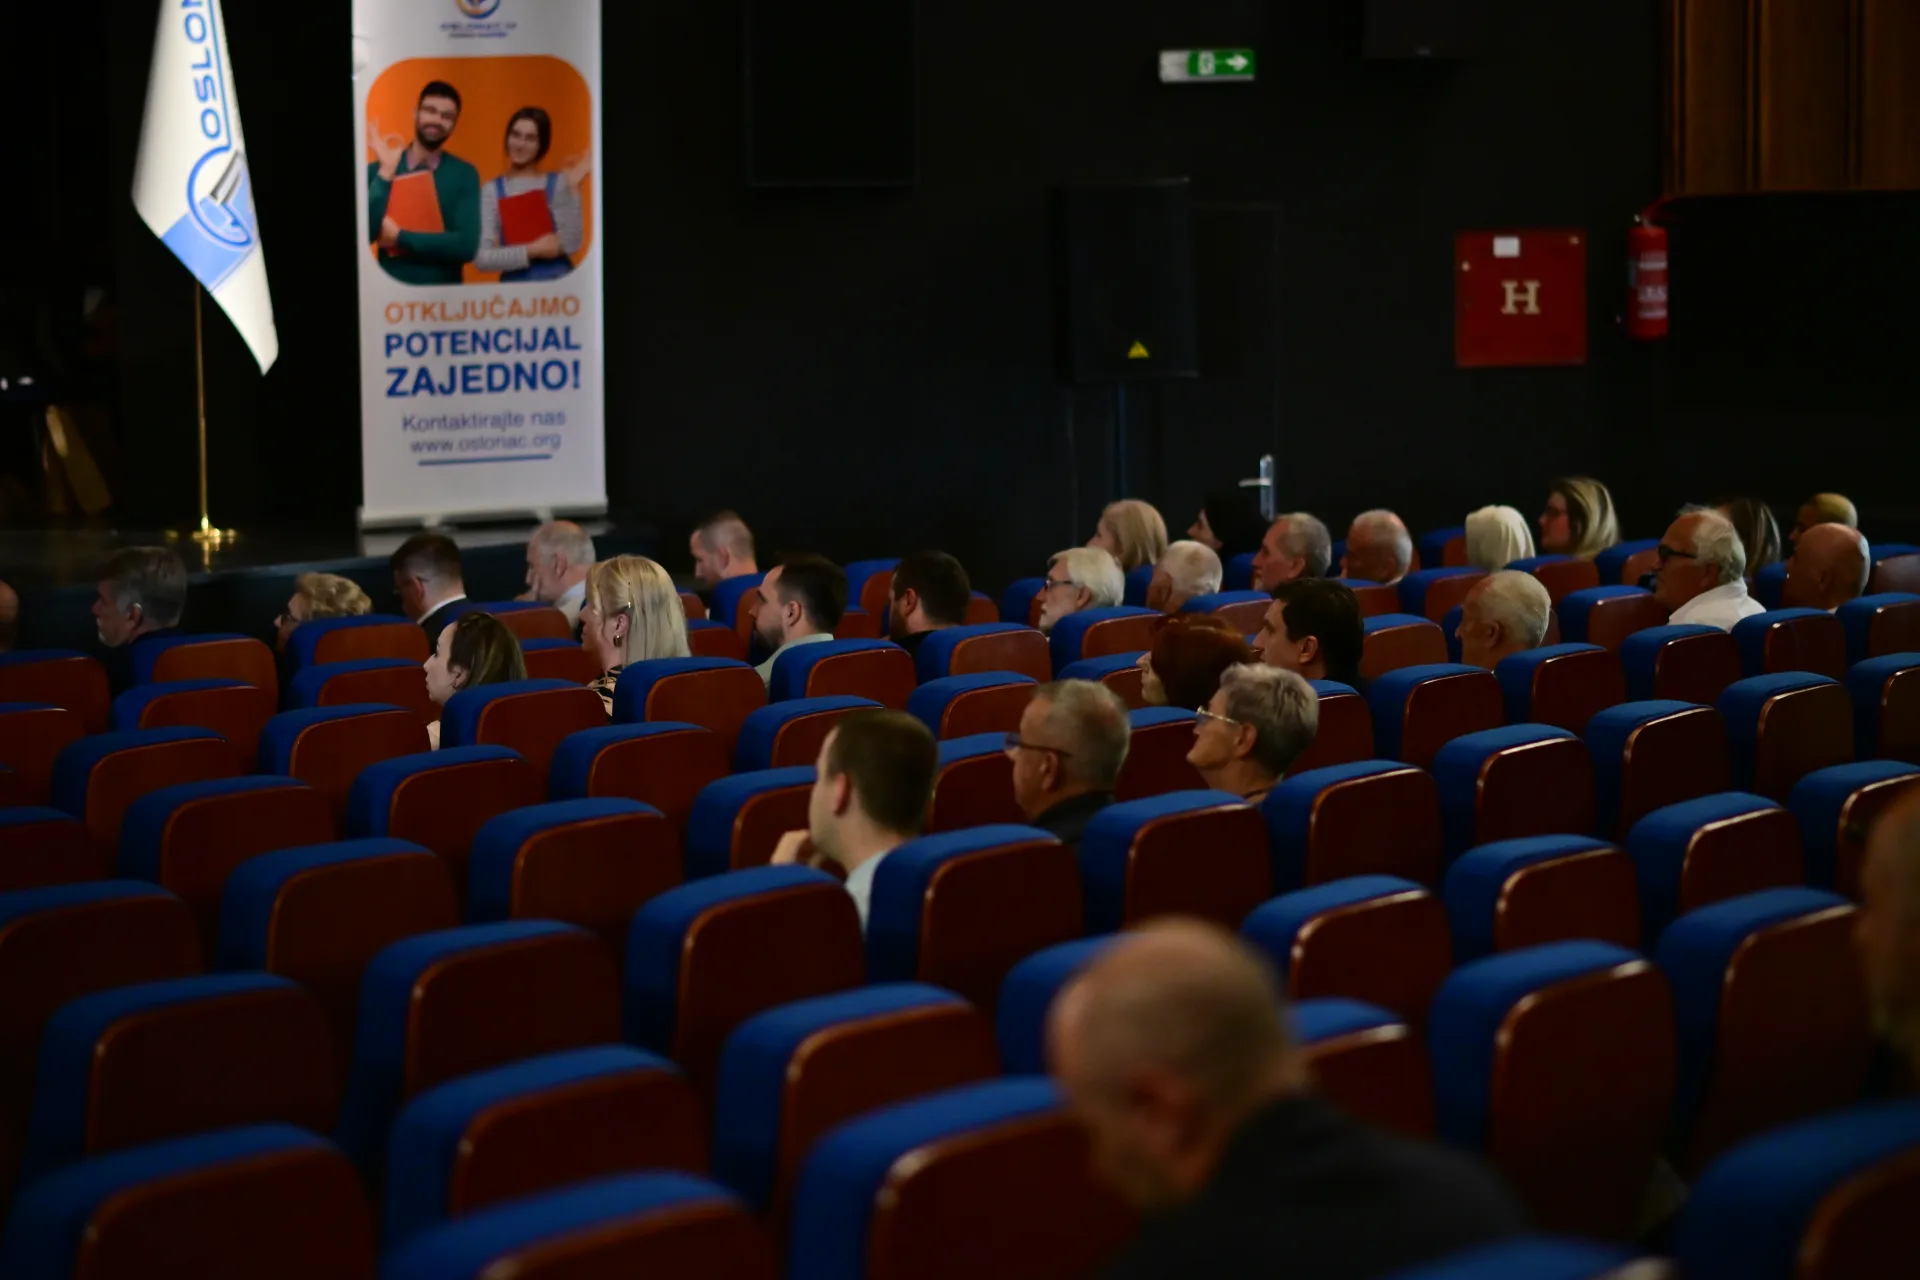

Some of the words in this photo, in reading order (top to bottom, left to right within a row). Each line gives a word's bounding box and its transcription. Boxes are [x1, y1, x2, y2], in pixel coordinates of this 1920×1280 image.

[384, 294, 581, 324] OTKLJUČAJMO
[1501, 280, 1541, 314] H
[384, 326, 582, 358] POTENCIJAL
[385, 359, 581, 398] ZAJEDNO!
[402, 411, 525, 432] Kontaktirajte
[530, 410, 567, 426] nas
[410, 433, 562, 453] www.oslonac.org
